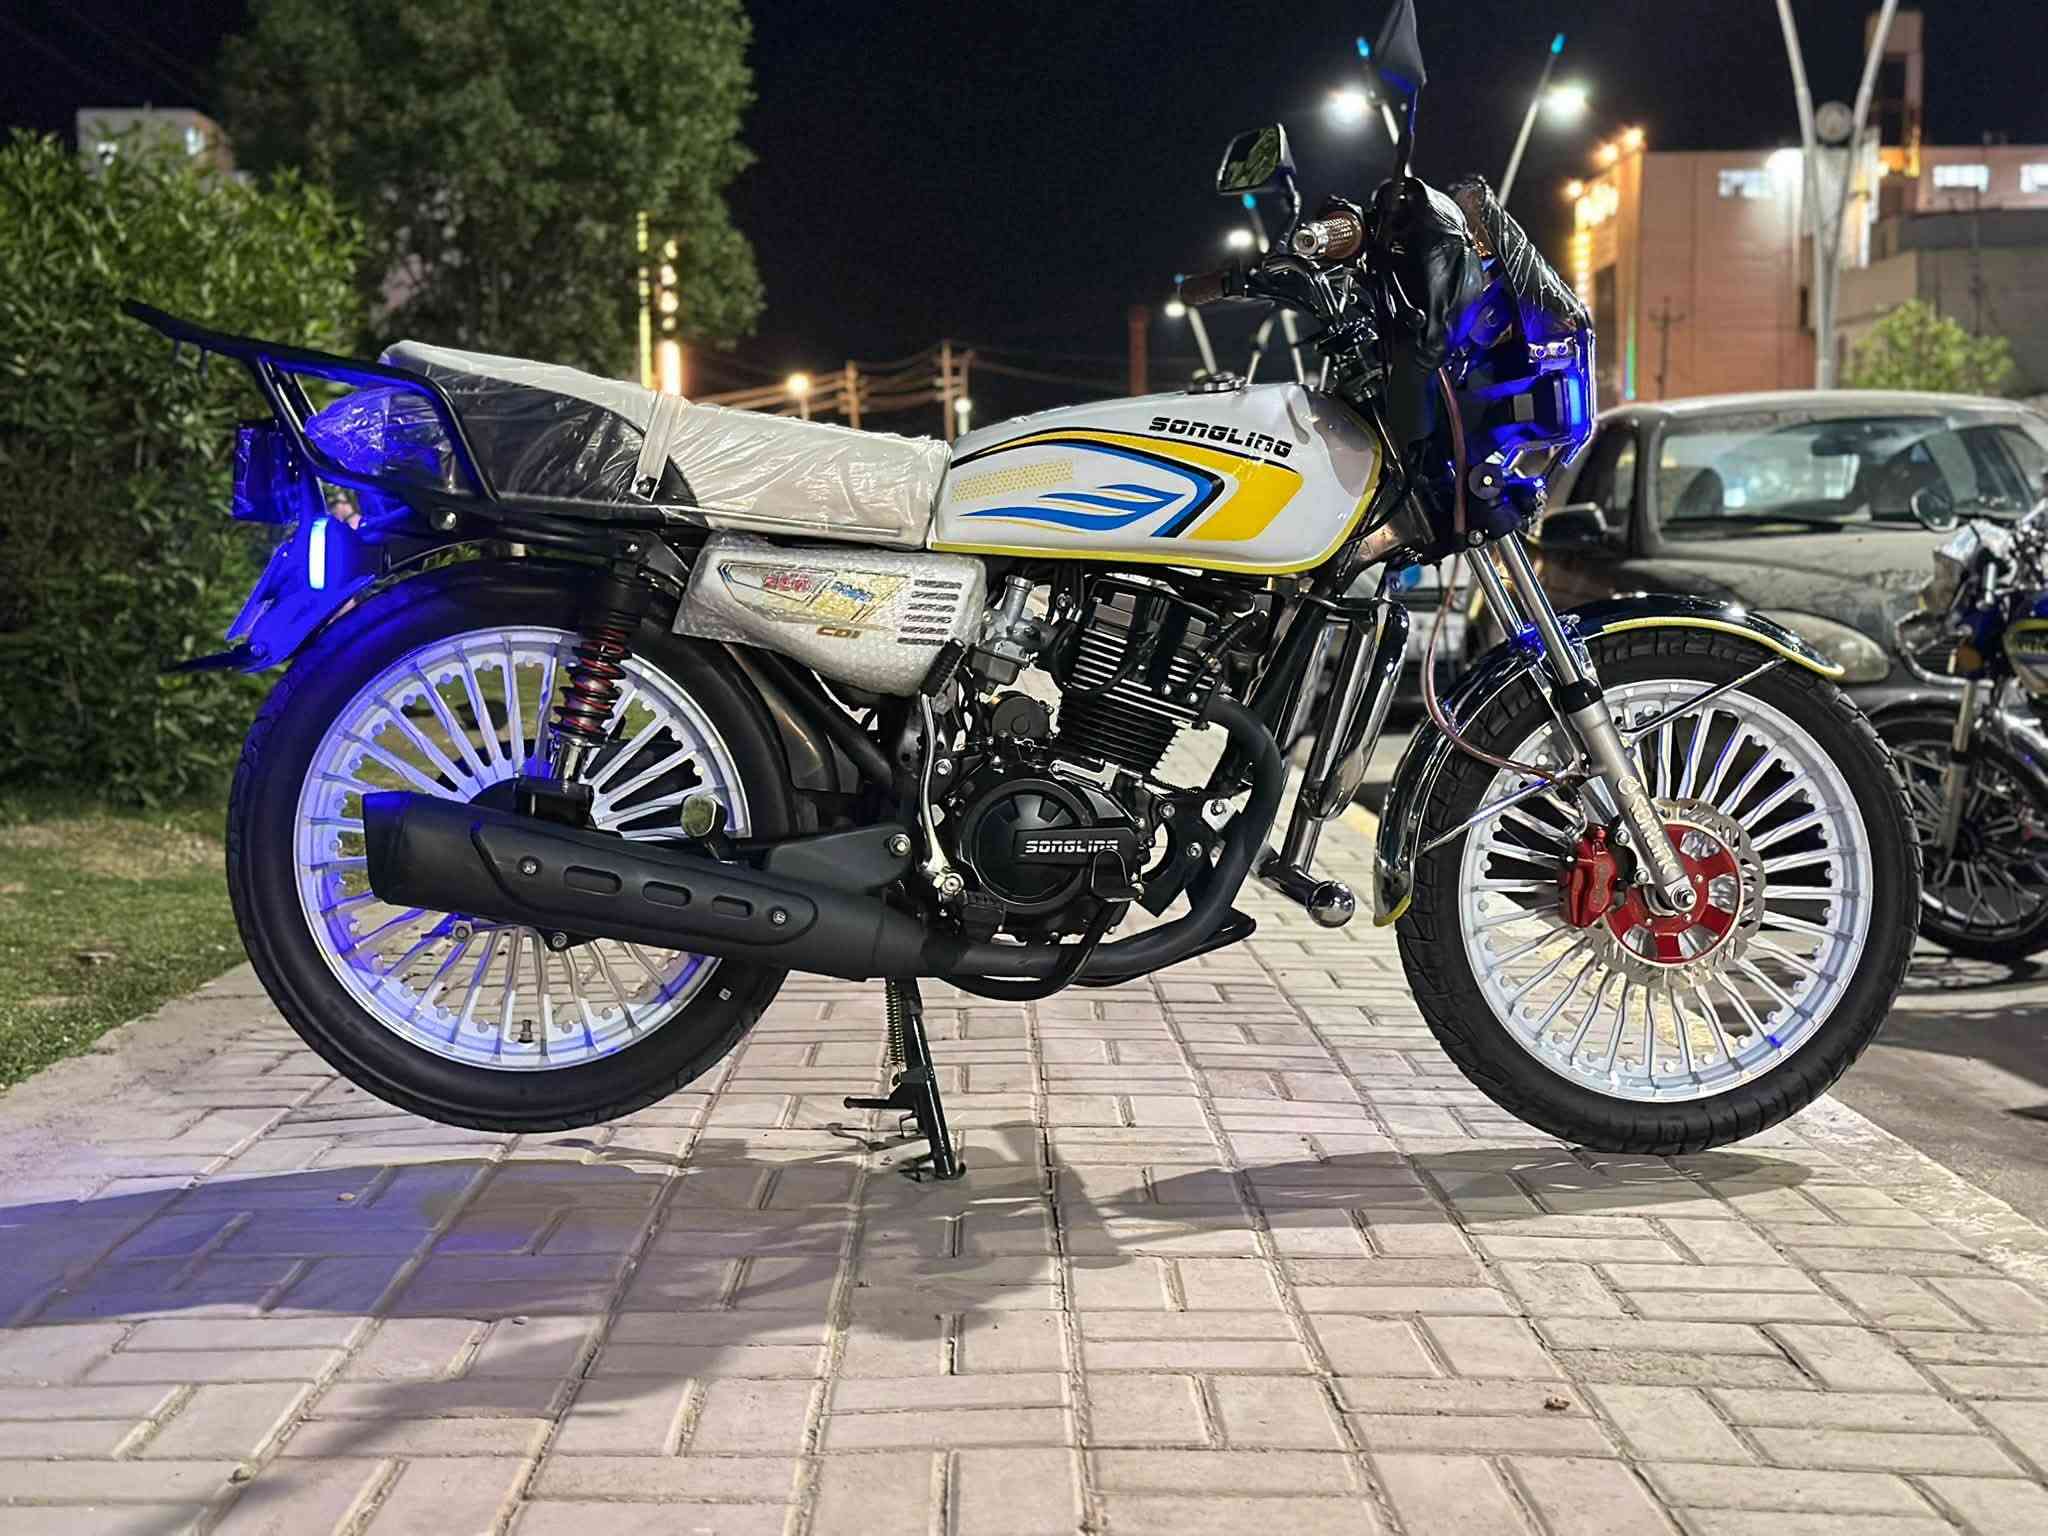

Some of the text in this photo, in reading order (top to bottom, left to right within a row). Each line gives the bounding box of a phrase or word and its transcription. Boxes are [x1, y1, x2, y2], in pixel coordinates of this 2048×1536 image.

[1149, 417, 1292, 458] SONGLING
[816, 627, 861, 639] CDI
[1025, 840, 1119, 853] SONGLING
